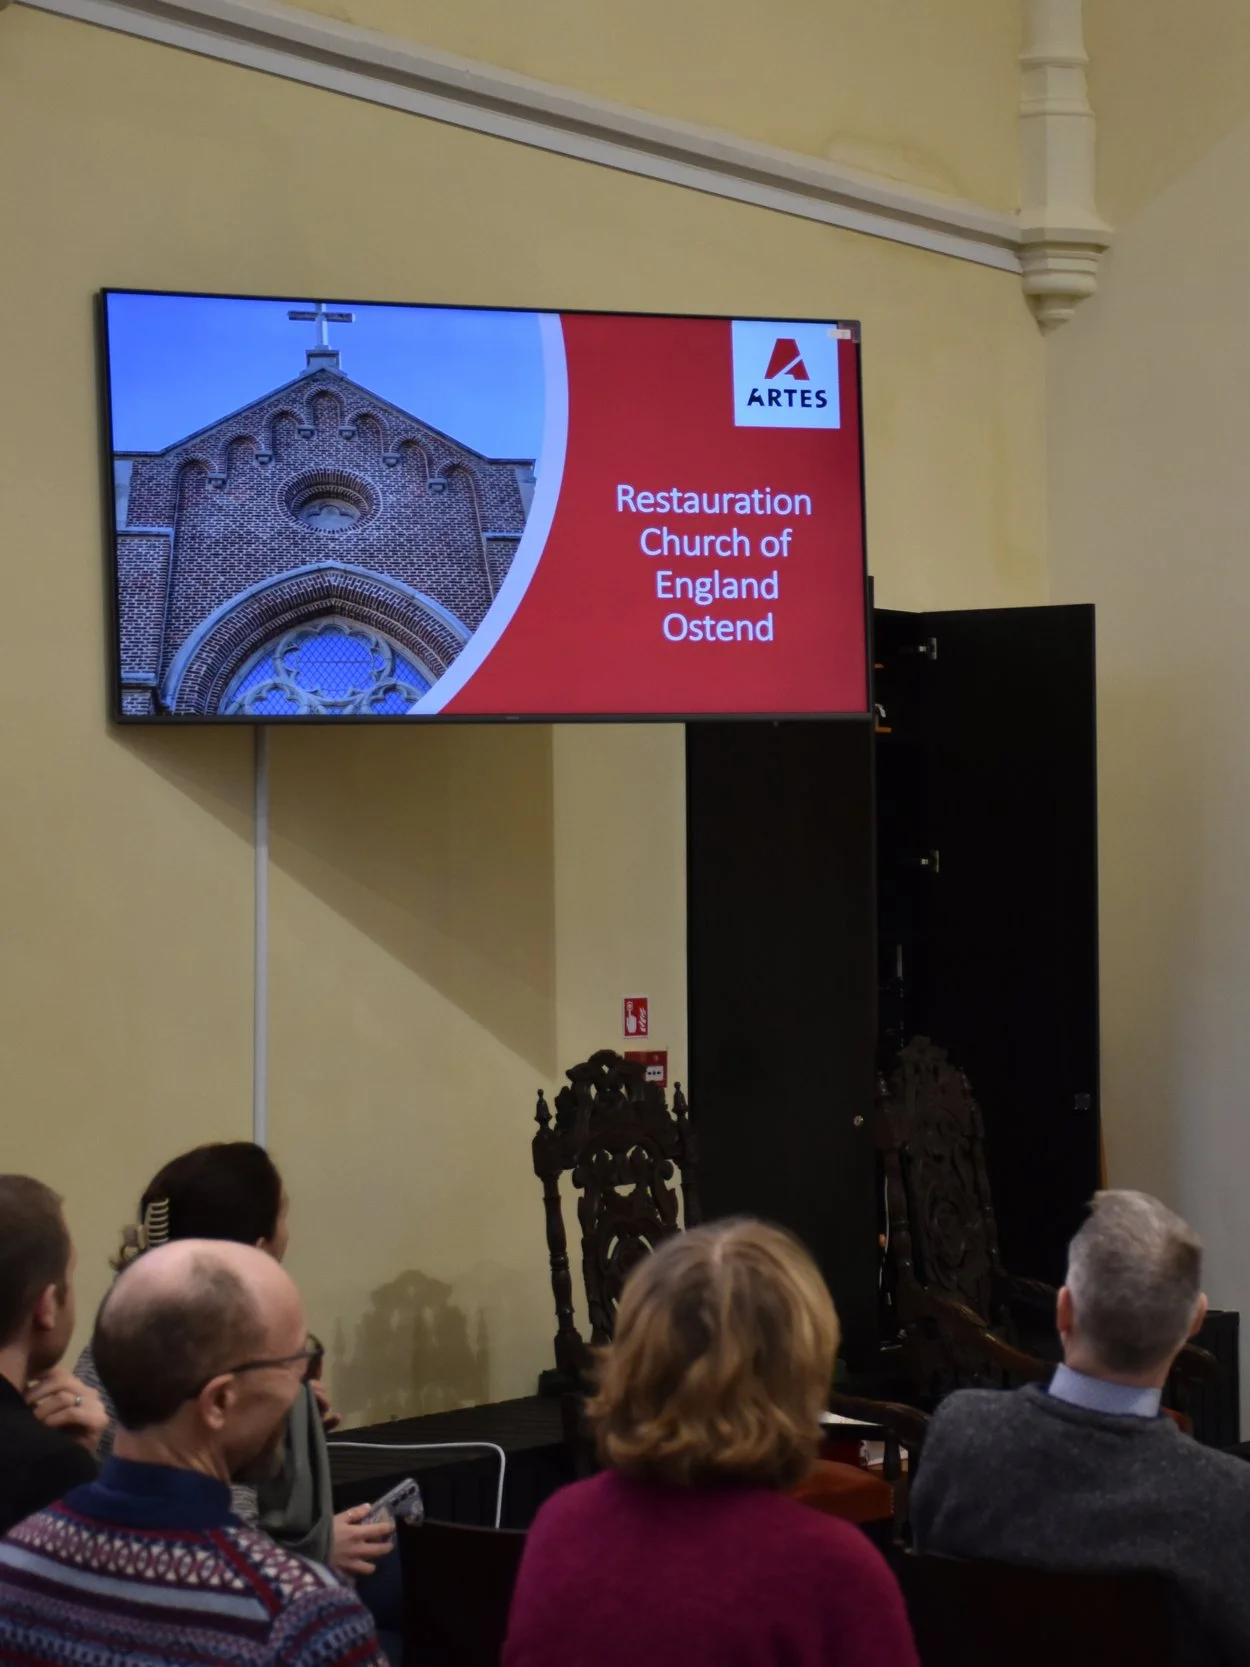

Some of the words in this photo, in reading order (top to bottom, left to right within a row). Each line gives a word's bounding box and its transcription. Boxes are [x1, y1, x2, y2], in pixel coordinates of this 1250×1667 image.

[747, 388, 828, 408] ARTES
[617, 484, 812, 515] Restauration
[640, 526, 751, 557] Church
[760, 528, 793, 558] of
[656, 569, 779, 606] England
[663, 612, 774, 642] Ostend
